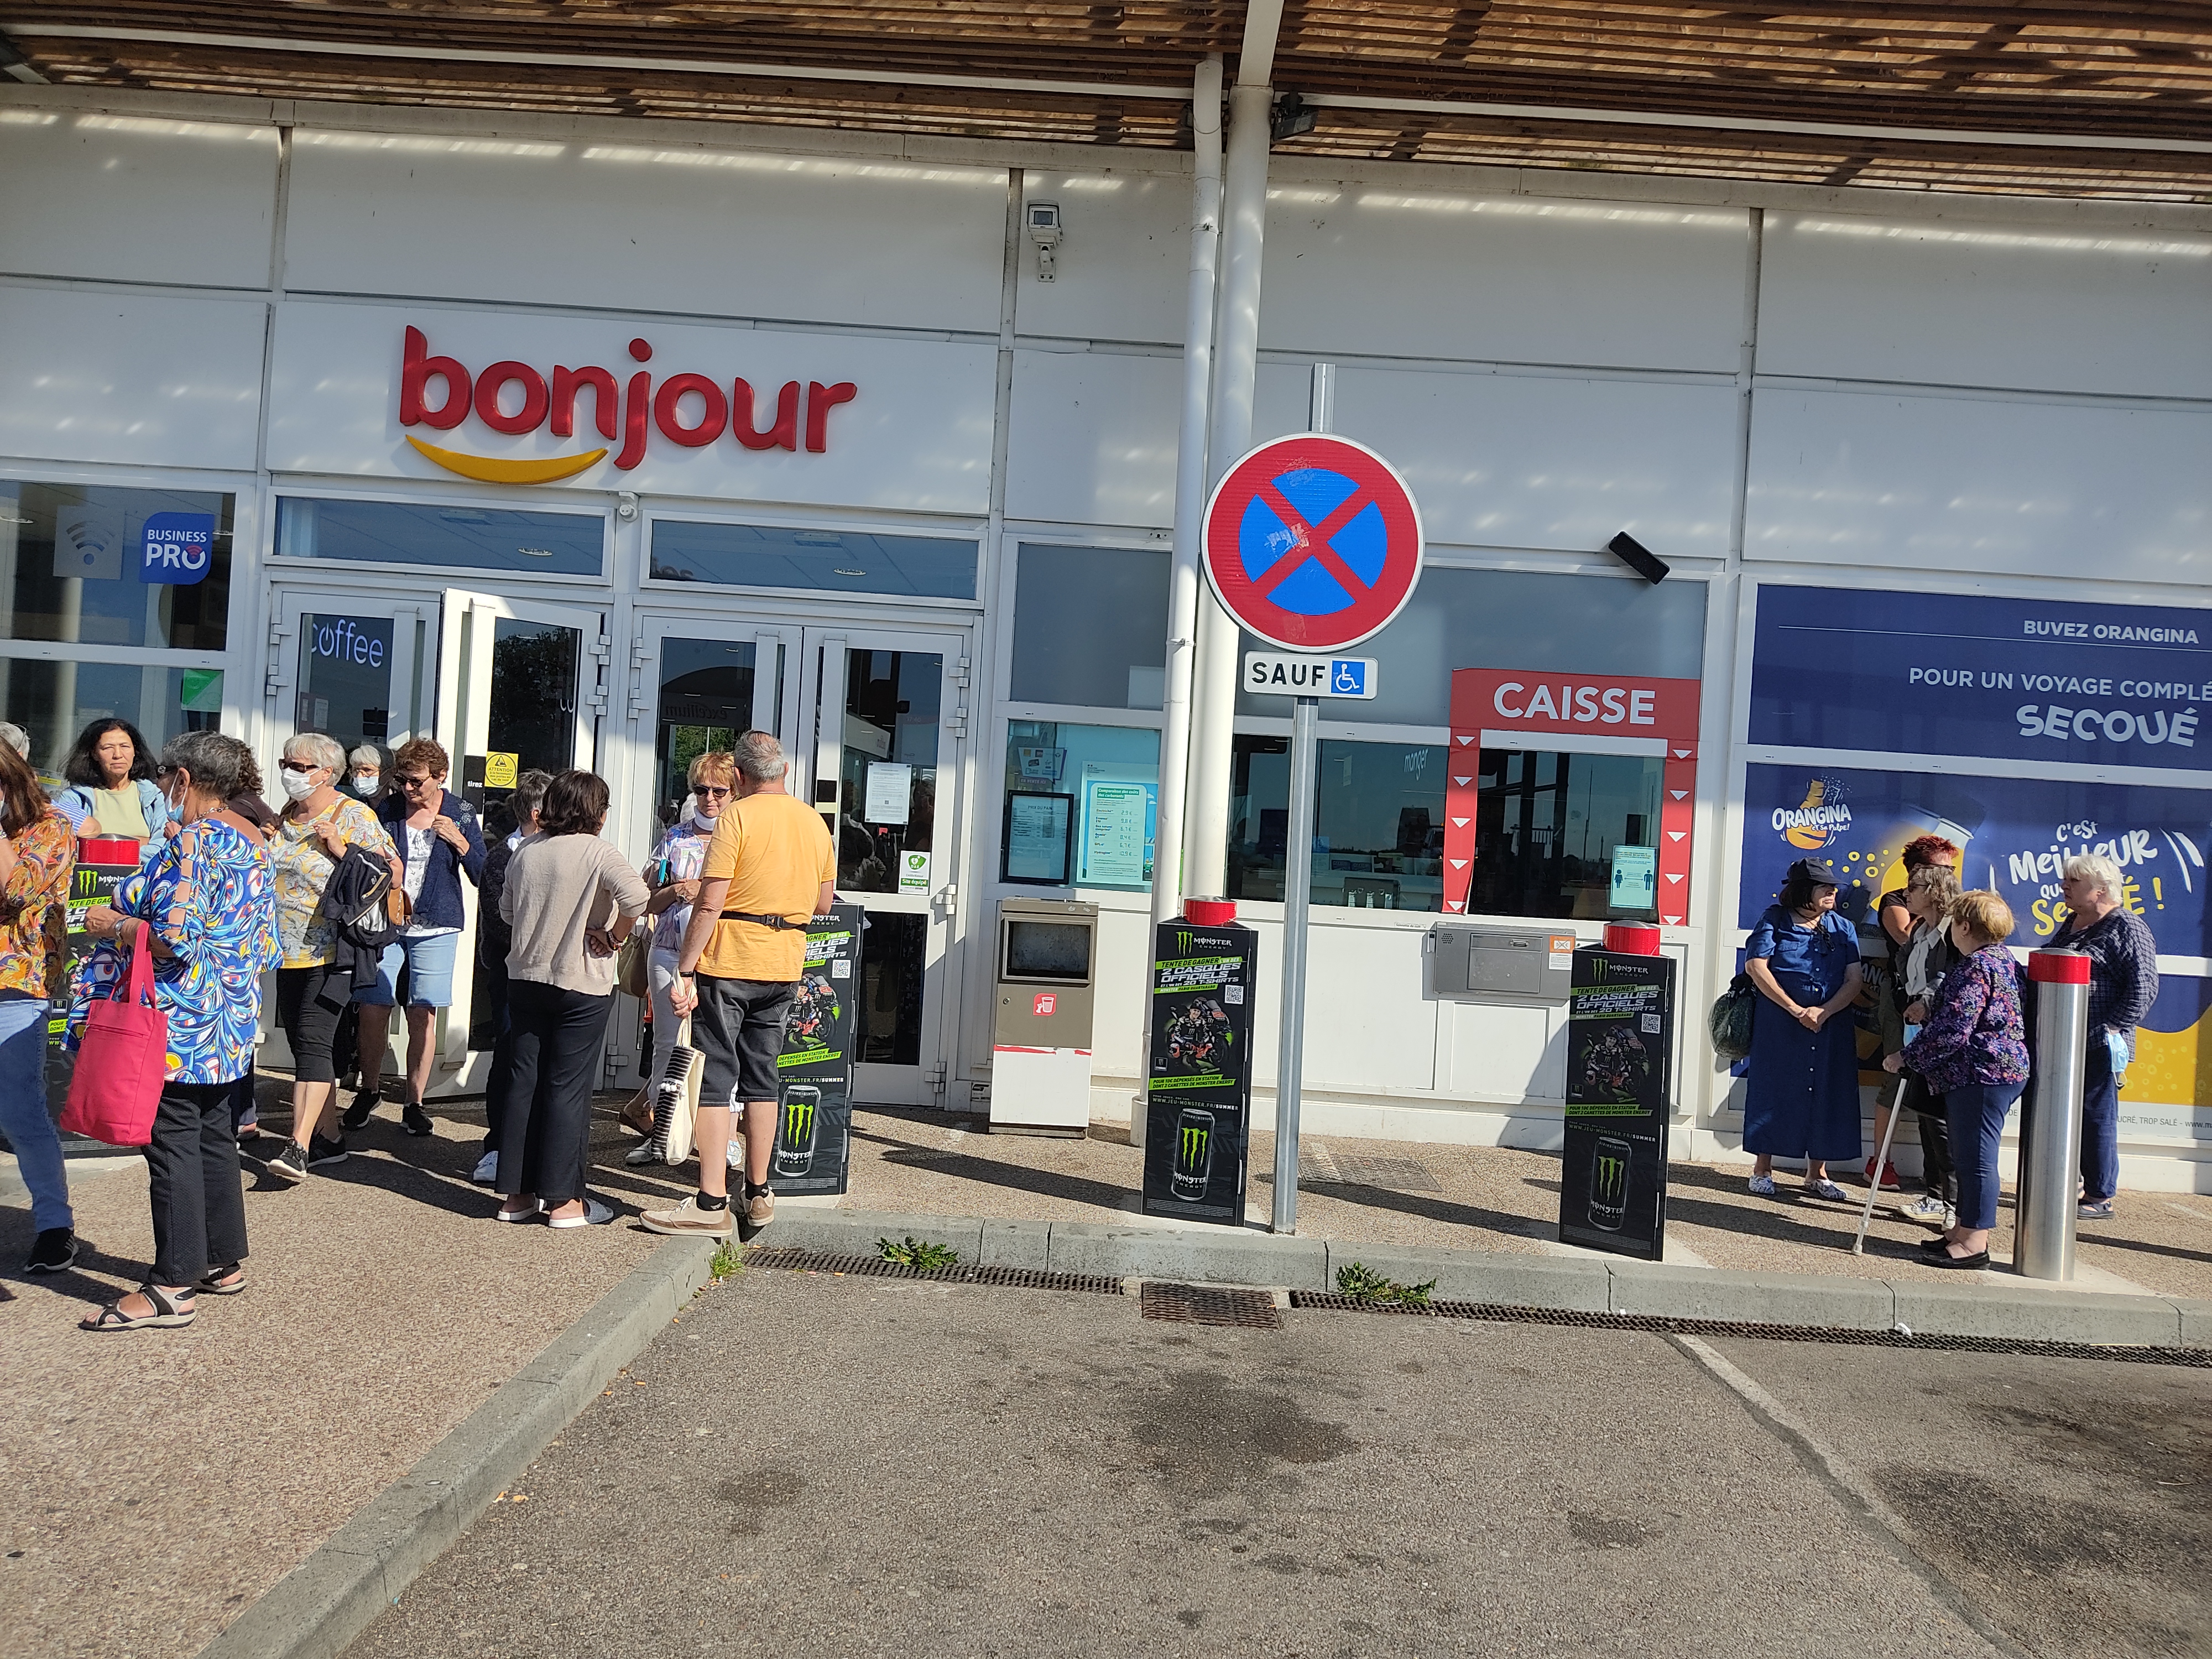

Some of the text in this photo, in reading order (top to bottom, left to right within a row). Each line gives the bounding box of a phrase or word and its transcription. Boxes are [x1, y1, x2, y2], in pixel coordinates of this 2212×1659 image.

[400, 325, 858, 471] bonjour
[147, 529, 207, 542] BUSINESS
[145, 542, 206, 570] PRO
[2023, 620, 2199, 644] BUVEZ ORANGINA
[1251, 661, 1326, 687] SAUF
[1909, 667, 1974, 687] POUR
[1981, 671, 2013, 690] UN
[2021, 674, 2112, 696] VOYAGE
[1494, 682, 1656, 725] CAISSE
[2016, 704, 2199, 748] SECOUÉ
[1404, 748, 1428, 780] manger
[1772, 804, 1852, 830] ORANGINA
[806, 937, 849, 949] SQUES
[1193, 937, 1233, 946] MONSTER
[806, 951, 847, 961] T-SHIRTS
[1193, 957, 1219, 966] GAGNER
[1174, 962, 1241, 974] CASQUES
[1609, 964, 1649, 974] MONSTER
[1161, 971, 1229, 983] OFFICIELS
[1199, 977, 1240, 985] T-SHIRTS
[1589, 991, 1659, 1001] CASQUES
[1576, 999, 1646, 1009] OFFICIELS
[2117, 1115, 2138, 1124] UCRÉ,
[2139, 1117, 2158, 1125] TROP
[2159, 1118, 2178, 1126] SALÉ
